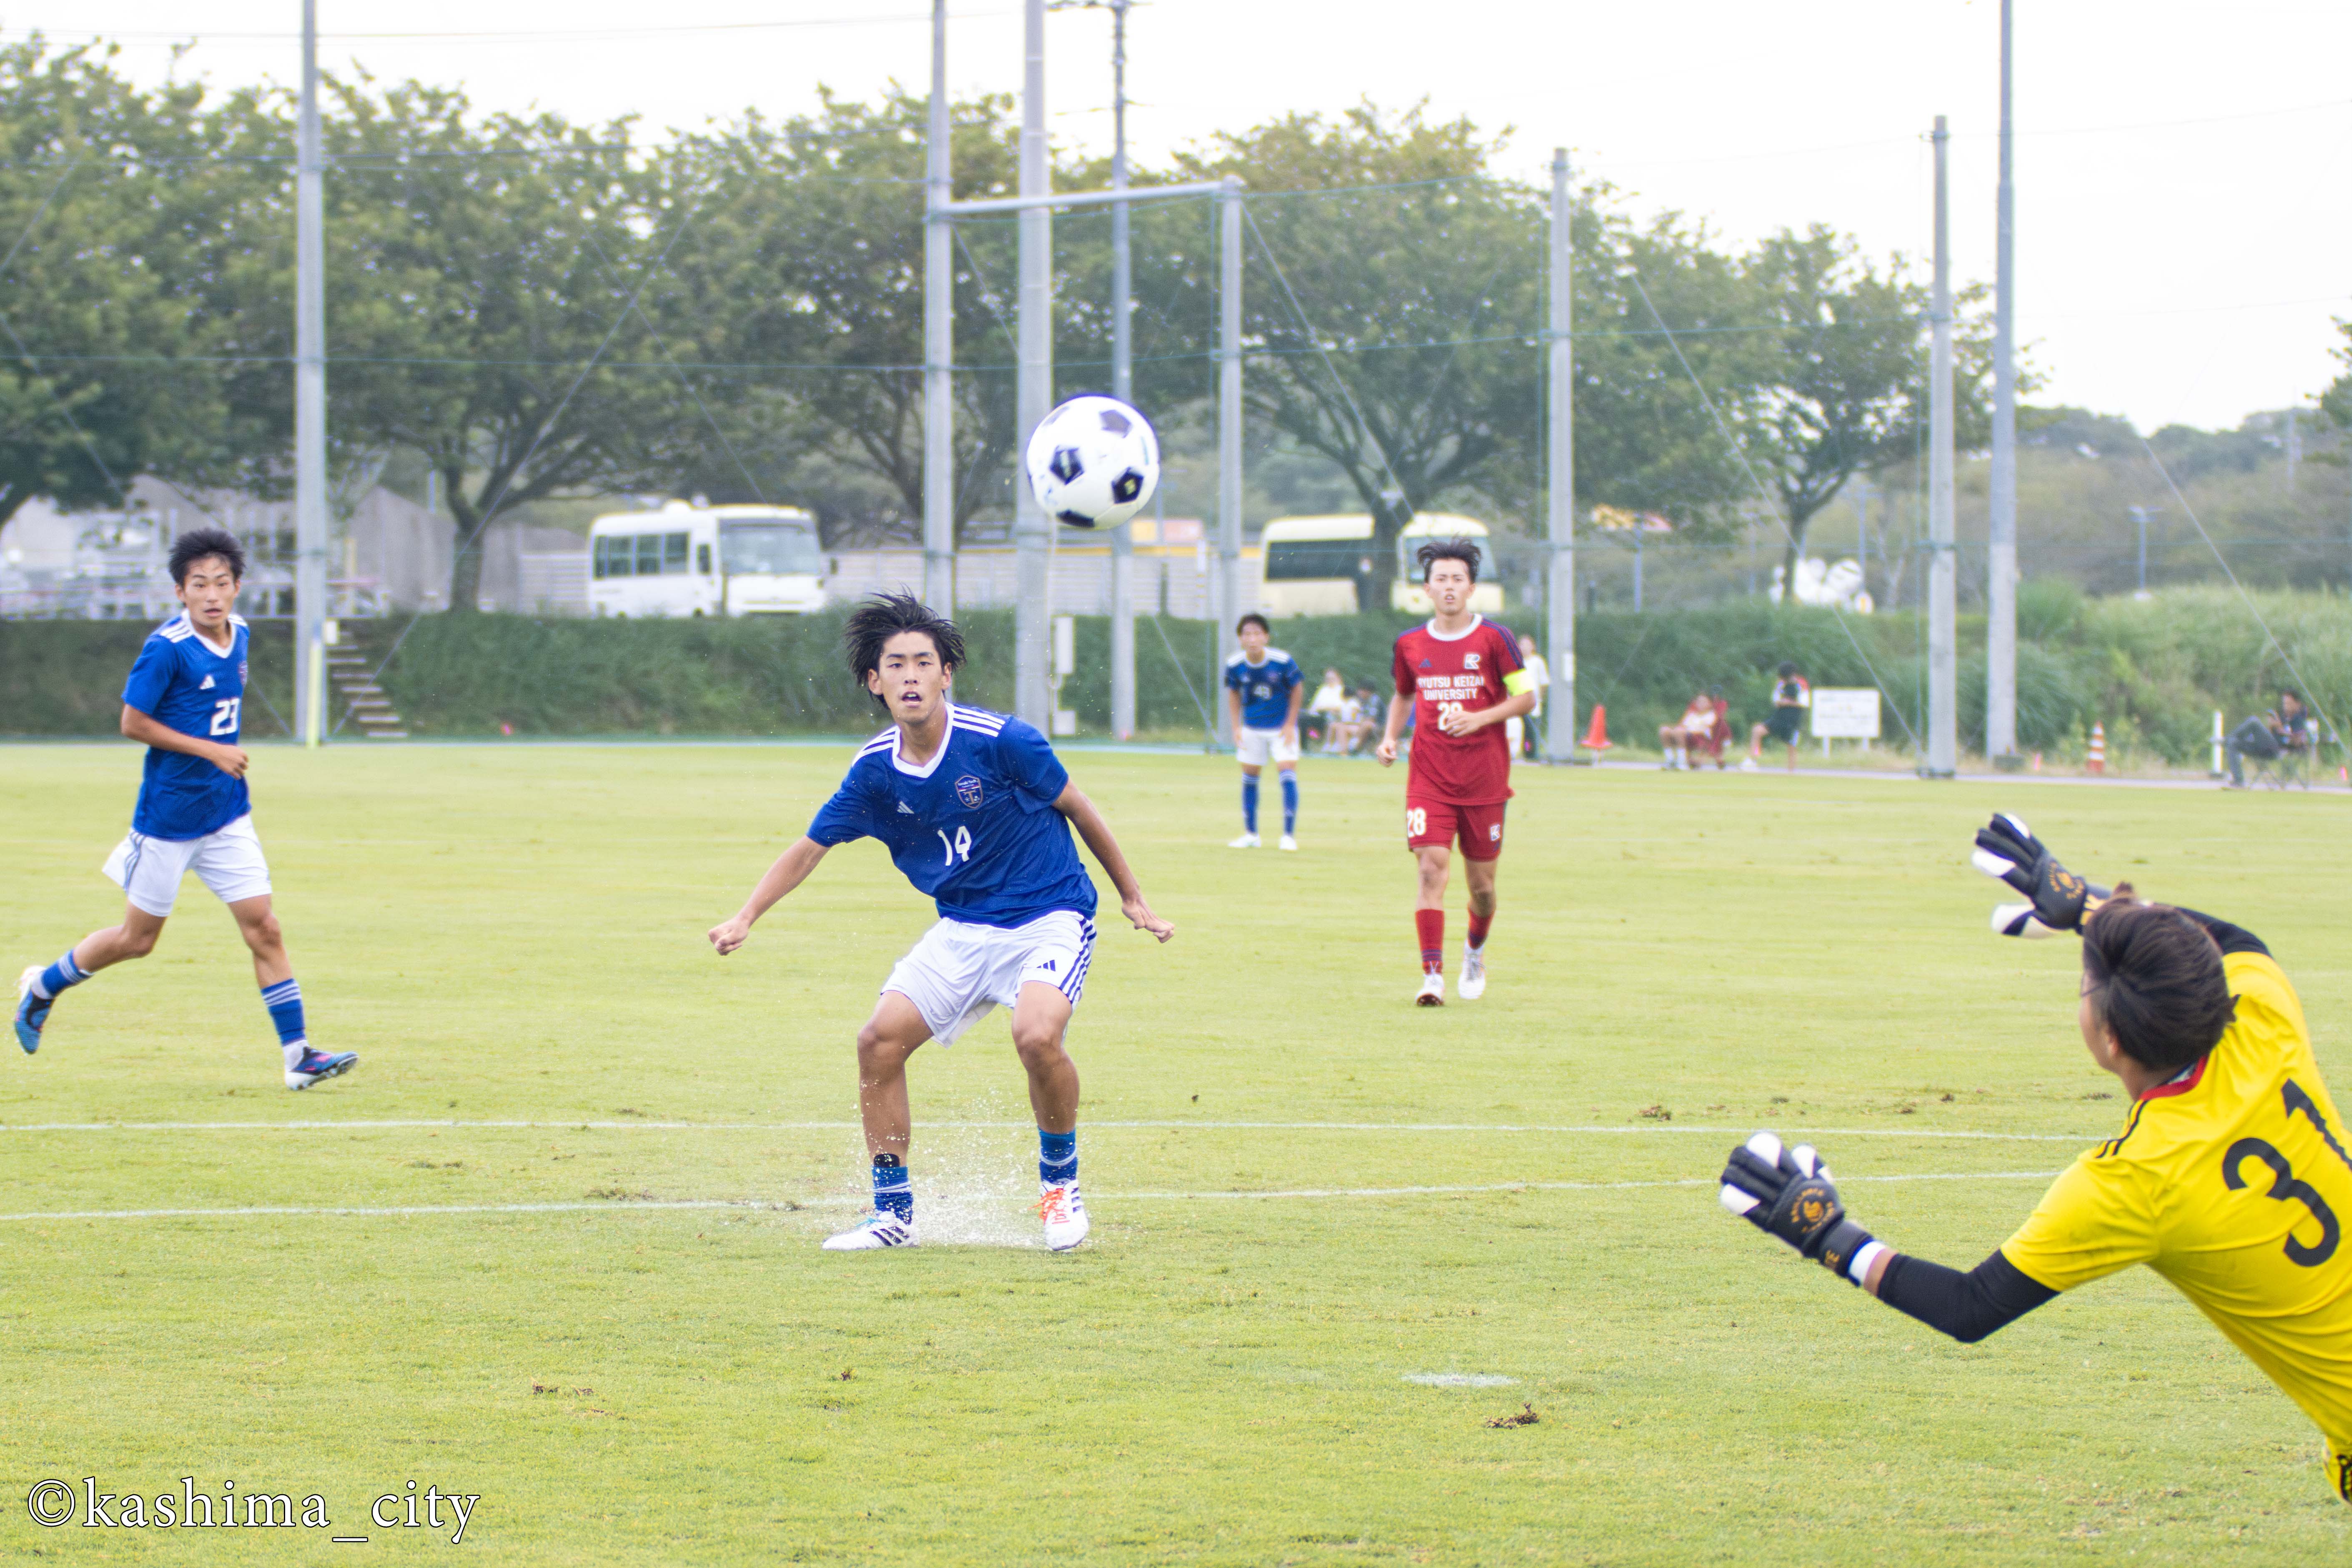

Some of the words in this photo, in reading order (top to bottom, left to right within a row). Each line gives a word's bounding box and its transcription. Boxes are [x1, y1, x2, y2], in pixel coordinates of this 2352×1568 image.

[1423, 688, 1477, 701] UNIVERSITY
[1453, 675, 1484, 687] KEIZAI
[211, 698, 240, 736] 23
[1407, 807, 1426, 838] 28
[937, 825, 972, 866] 14
[2221, 1077, 2352, 1267] 31
